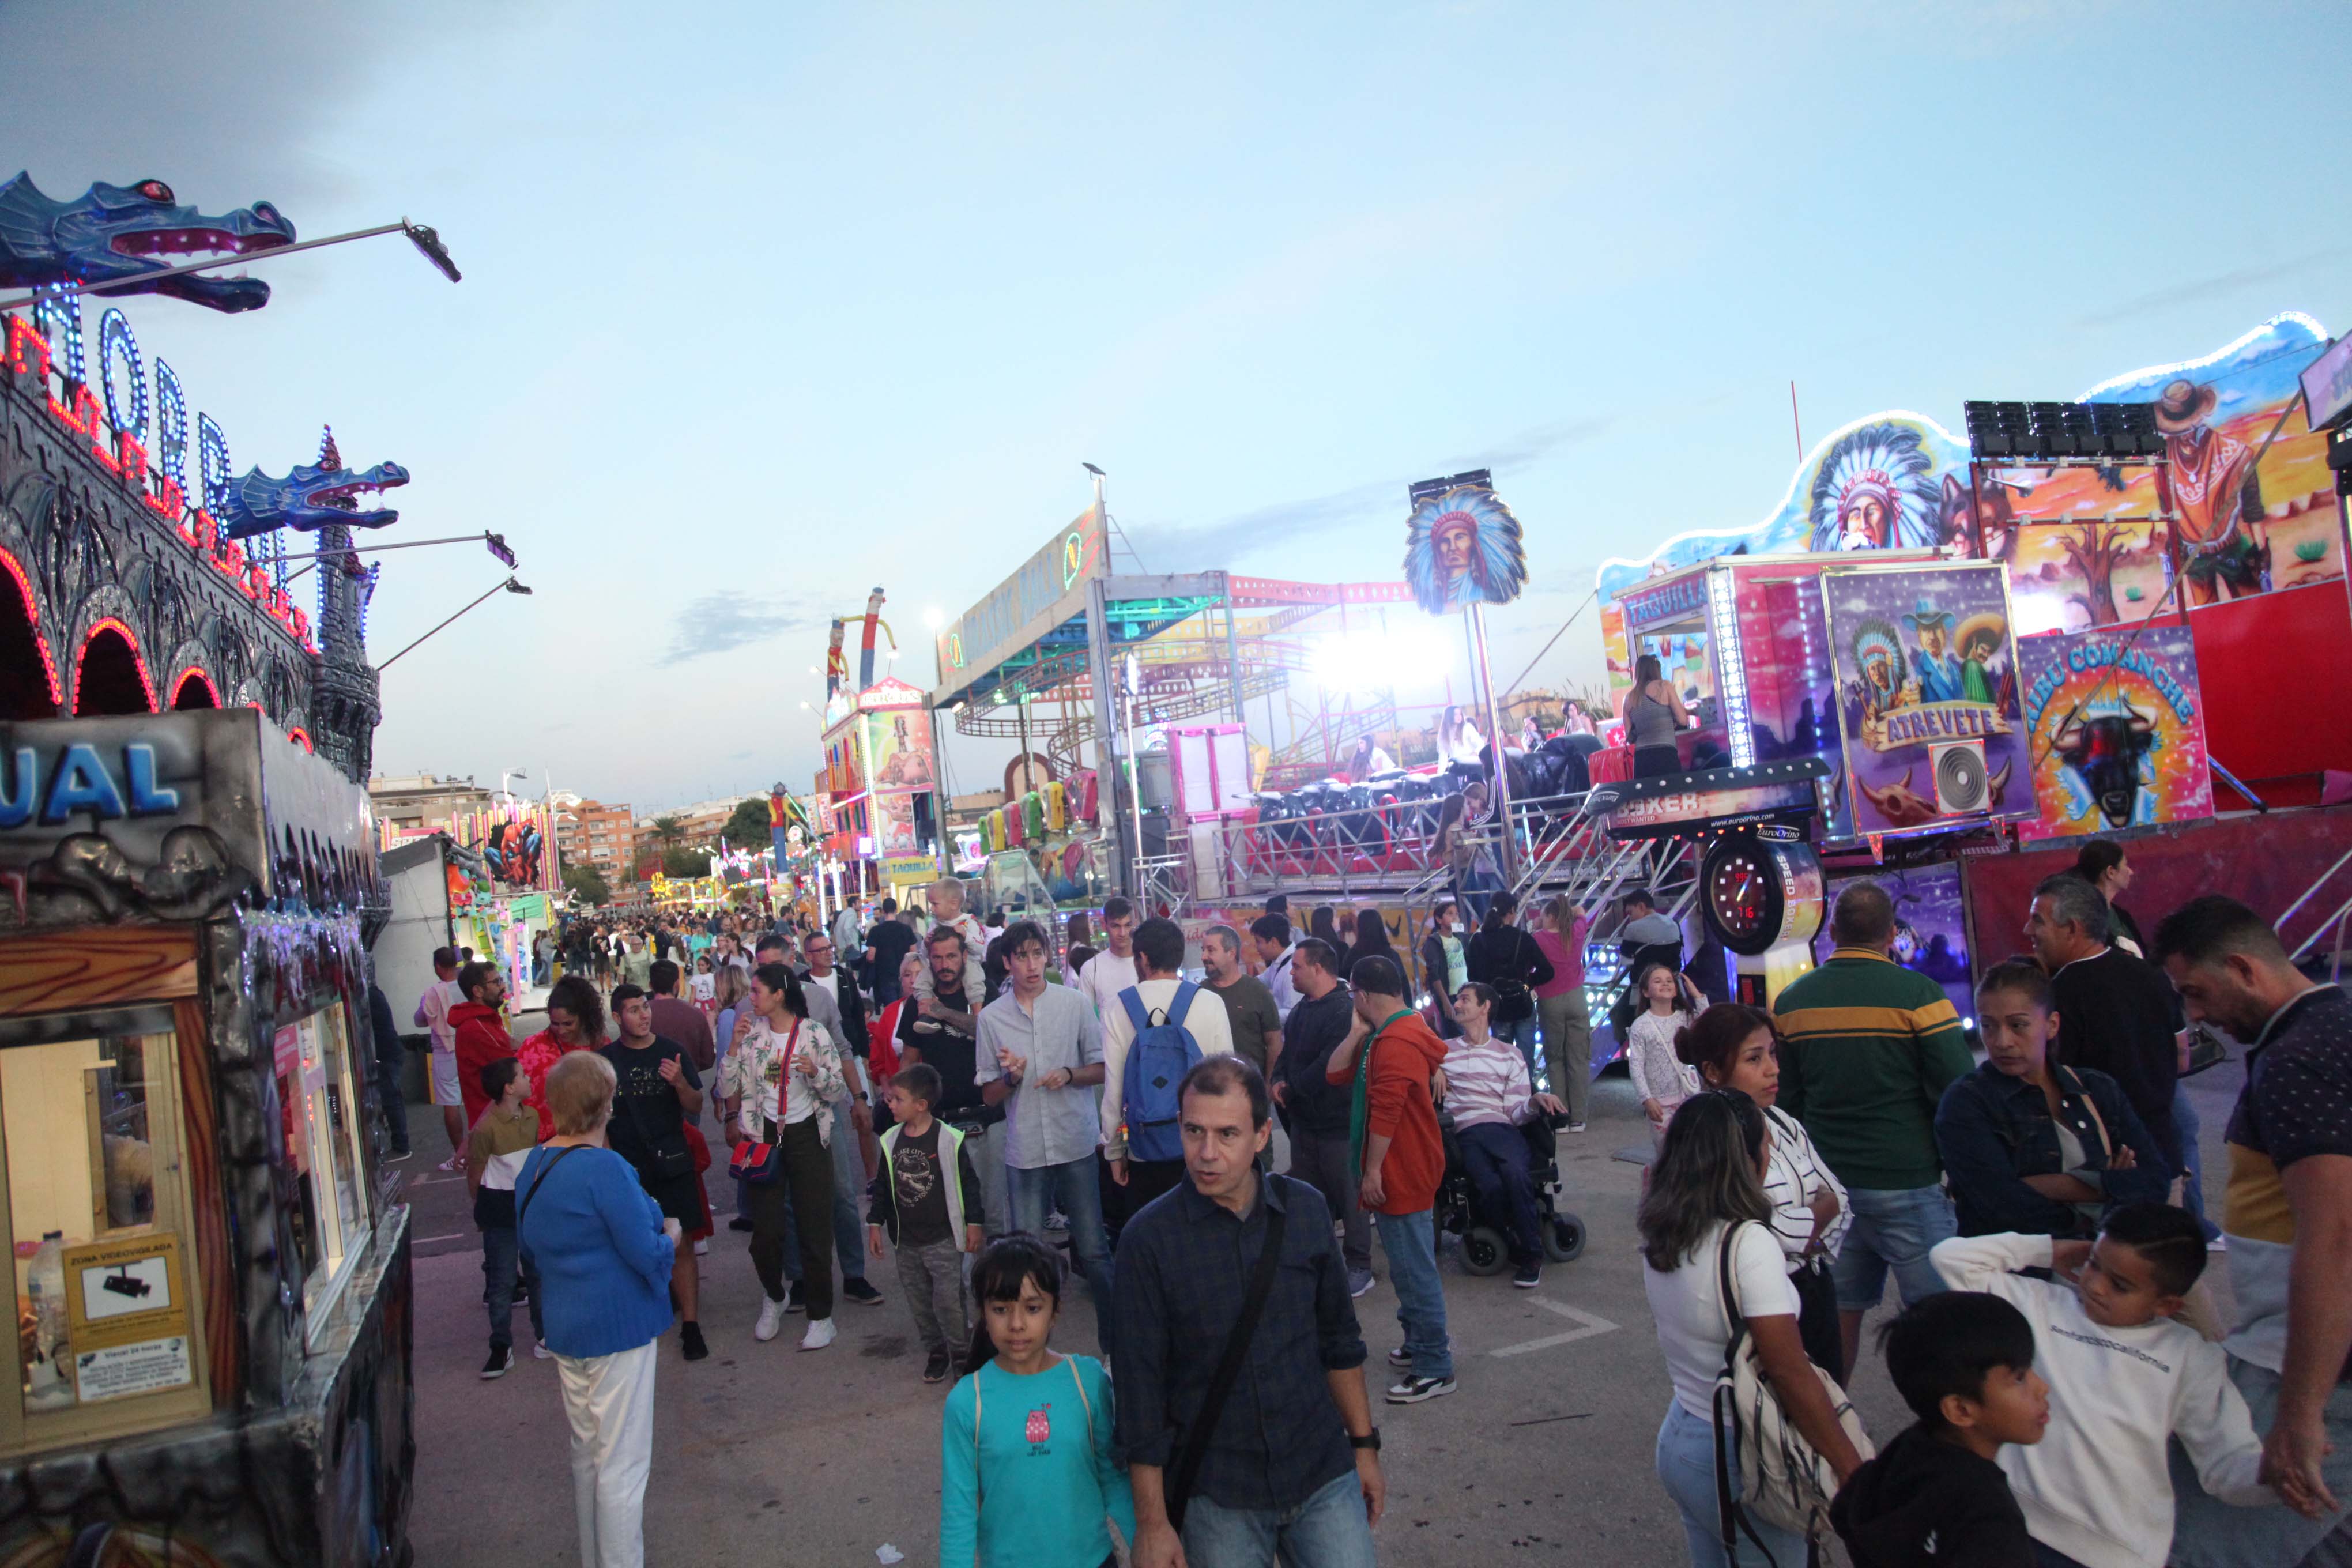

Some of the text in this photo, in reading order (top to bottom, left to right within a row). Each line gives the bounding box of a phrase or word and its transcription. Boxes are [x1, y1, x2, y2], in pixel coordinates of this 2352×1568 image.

[1626, 577, 1708, 625] TAQUILLA
[2025, 642, 2194, 733] RIBU COMANCHE
[1887, 708, 1995, 742] ATREVETE
[1616, 793, 1697, 817] BOXER
[1630, 815, 1656, 823] WANTED
[1711, 813, 1775, 827] www.euroorino.com
[1757, 827, 1800, 839] EuroOrino
[892, 861, 935, 873] TAQUILLA
[1777, 855, 1795, 895] SPEED
[1737, 906, 1755, 918] 716
[71, 1242, 172, 1266] ZONA VIDEOVIGILADA
